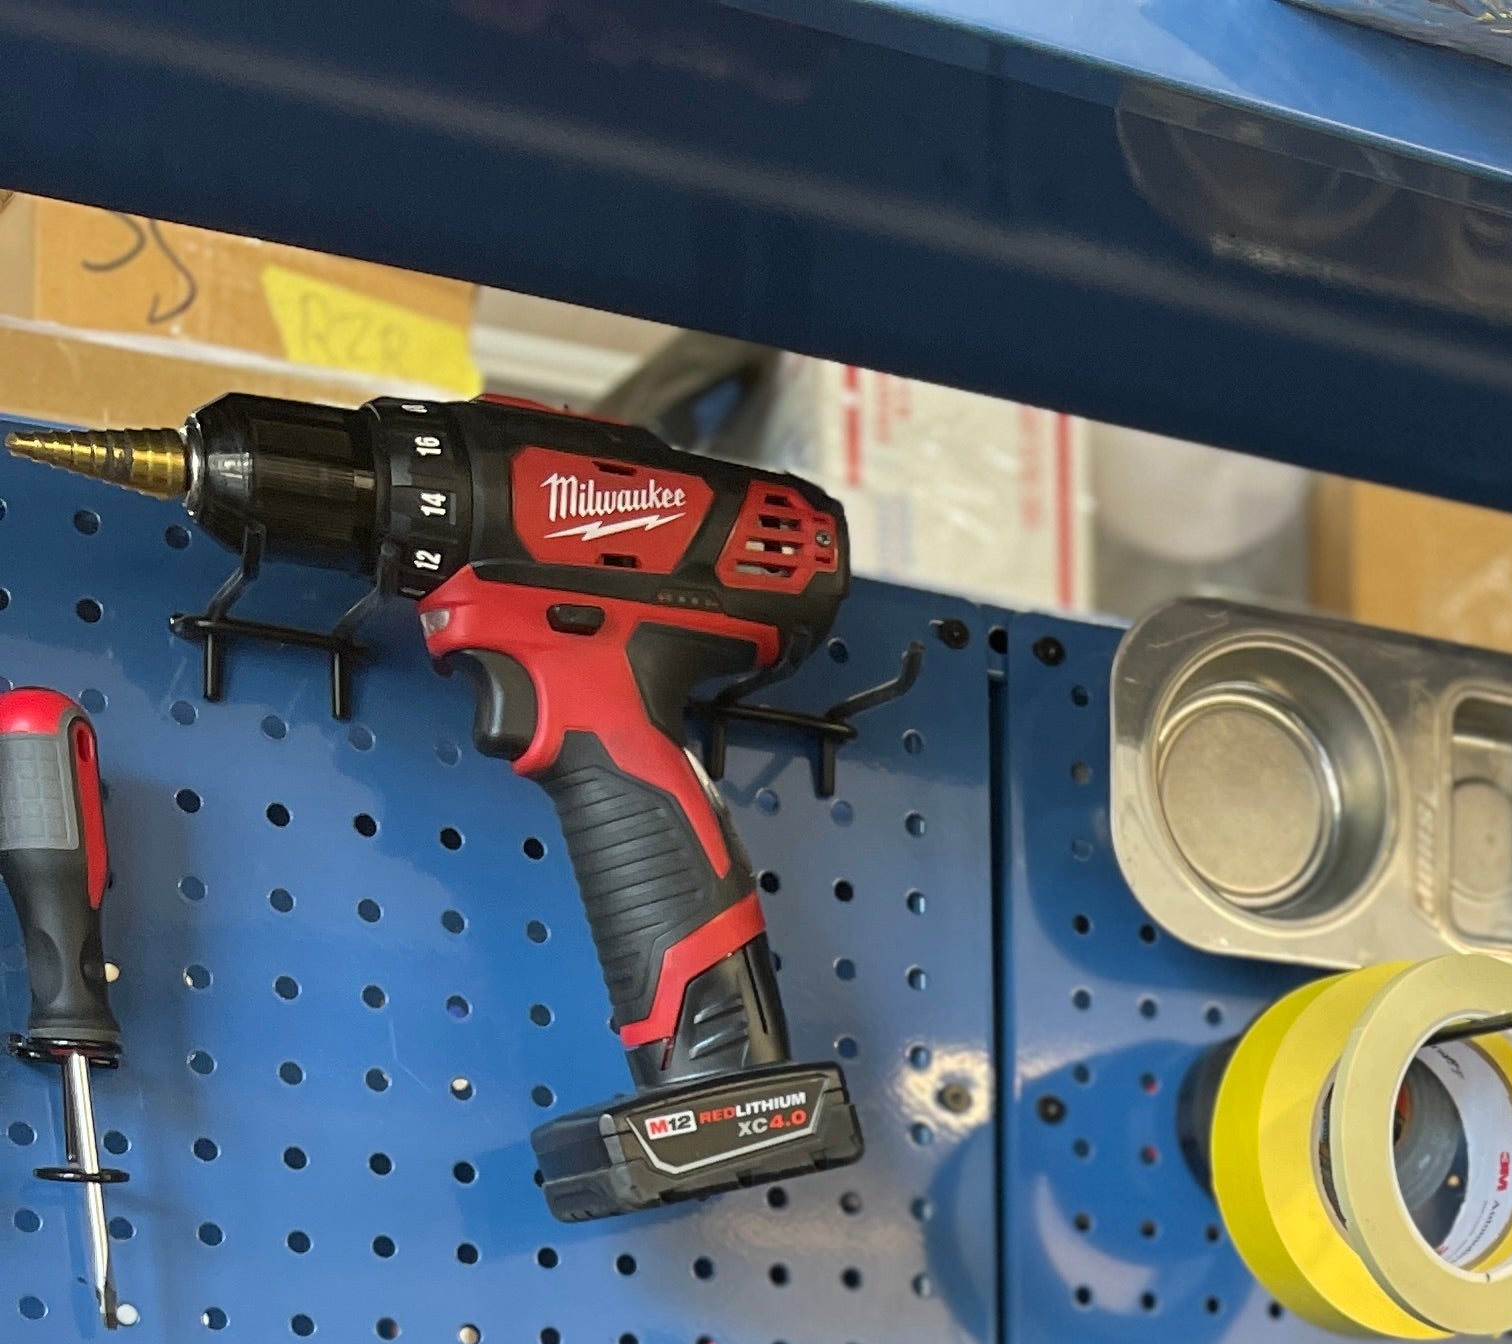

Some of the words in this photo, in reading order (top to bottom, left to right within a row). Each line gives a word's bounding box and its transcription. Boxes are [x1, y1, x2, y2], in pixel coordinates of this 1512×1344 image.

[414, 436, 442, 457] 16
[420, 492, 446, 516] 14
[540, 472, 687, 522] Milwaukee
[413, 550, 442, 571] 12
[648, 1115, 692, 1135] M12
[699, 1091, 807, 1125] REDLITHIUM
[1496, 1151, 1511, 1192] 3M
